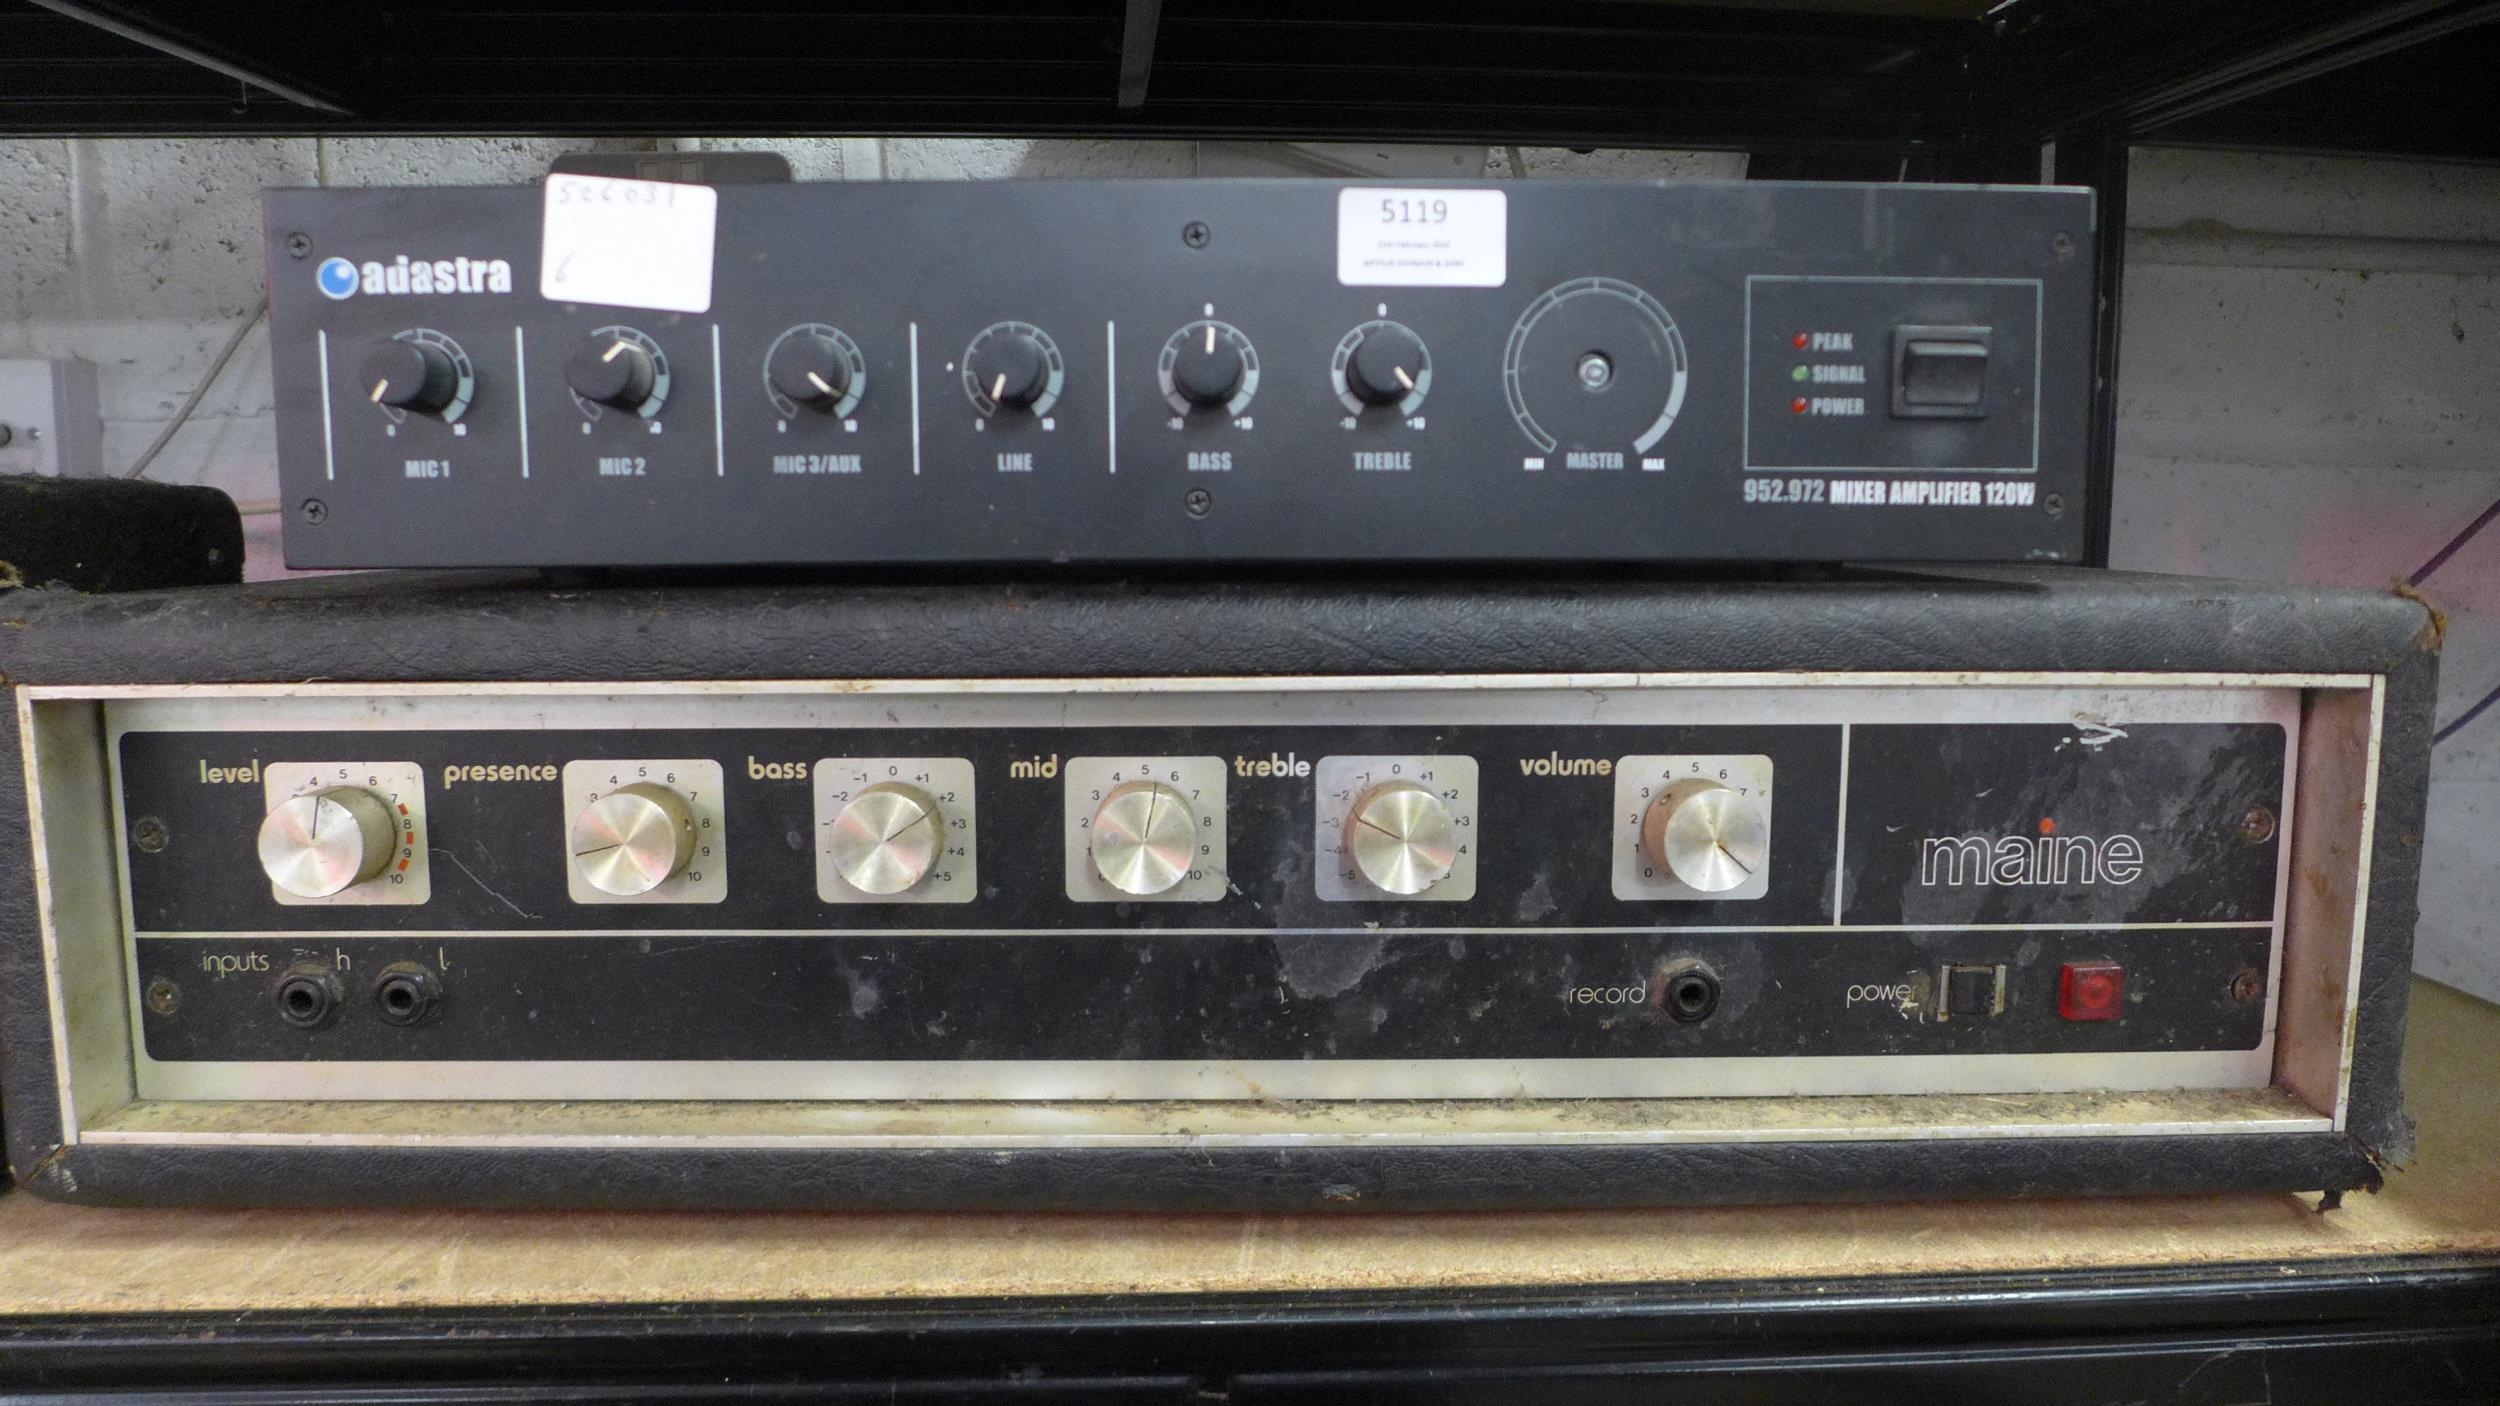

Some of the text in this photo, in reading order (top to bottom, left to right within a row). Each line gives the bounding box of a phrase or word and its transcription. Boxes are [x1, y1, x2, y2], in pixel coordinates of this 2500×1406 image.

[1381, 199, 1448, 223] 5119
[361, 255, 512, 295] adastra
[1813, 333, 1853, 351] PEAK
[1812, 365, 1866, 384] SIGNAL
[1811, 398, 1865, 416] POWER
[773, 454, 862, 474] MIC 3/AUX
[997, 453, 1034, 472] LINE
[1188, 451, 1232, 472] BASS
[1353, 451, 1412, 471] TREBLE
[1566, 452, 1624, 470] MASTER
[405, 460, 450, 478] MIC 1
[599, 457, 646, 476] MIC 2
[1743, 479, 2036, 505] 952.972 MIXER AMPLIFIER 120W
[748, 755, 808, 780] bass
[1010, 753, 1058, 778] mid
[1234, 752, 1311, 777] treble
[1520, 751, 1612, 776] volume
[1692, 762, 1699, 773] 5
[200, 759, 260, 783] level
[339, 769, 348, 779] 5
[639, 767, 647, 777] 5
[888, 766, 898, 776] 0
[1142, 765, 1149, 775] 5
[1392, 764, 1400, 774] 0
[1720, 769, 1727, 779] 6
[444, 764, 558, 789] presence
[609, 775, 618, 785] 4
[667, 773, 675, 784] 6
[915, 773, 929, 783] +1
[1112, 772, 1120, 782] 4
[1171, 771, 1179, 781] 6
[1419, 772, 1433, 781] +1
[1662, 770, 1671, 780] 4
[310, 777, 318, 786] 4
[369, 776, 377, 786] 6
[690, 792, 697, 801] 7
[939, 792, 954, 802] +2
[1092, 790, 1100, 800] 3
[1192, 790, 1200, 800] 7
[1442, 789, 1458, 799] +2
[1642, 787, 1649, 798] 3
[1740, 788, 1747, 796] 7
[391, 794, 398, 803] 7
[403, 819, 412, 829] 8
[702, 818, 710, 828] 8
[950, 818, 966, 829] +3
[1081, 818, 1088, 828] 2
[1203, 817, 1212, 827] 8
[1454, 817, 1470, 826] +3
[1631, 814, 1638, 824] 2
[403, 848, 412, 858] 9
[702, 847, 710, 856] 9
[948, 847, 965, 856] +4
[1201, 845, 1209, 855] 9
[1634, 843, 1639, 853] 1
[1921, 817, 2144, 886] maine
[688, 872, 701, 882] 10
[934, 871, 952, 881] +5
[1188, 870, 1202, 880] 10
[1645, 867, 1653, 878] 0
[391, 874, 403, 884] 10
[336, 947, 351, 971] h
[202, 950, 271, 979] inputs
[1569, 980, 1647, 1004] record
